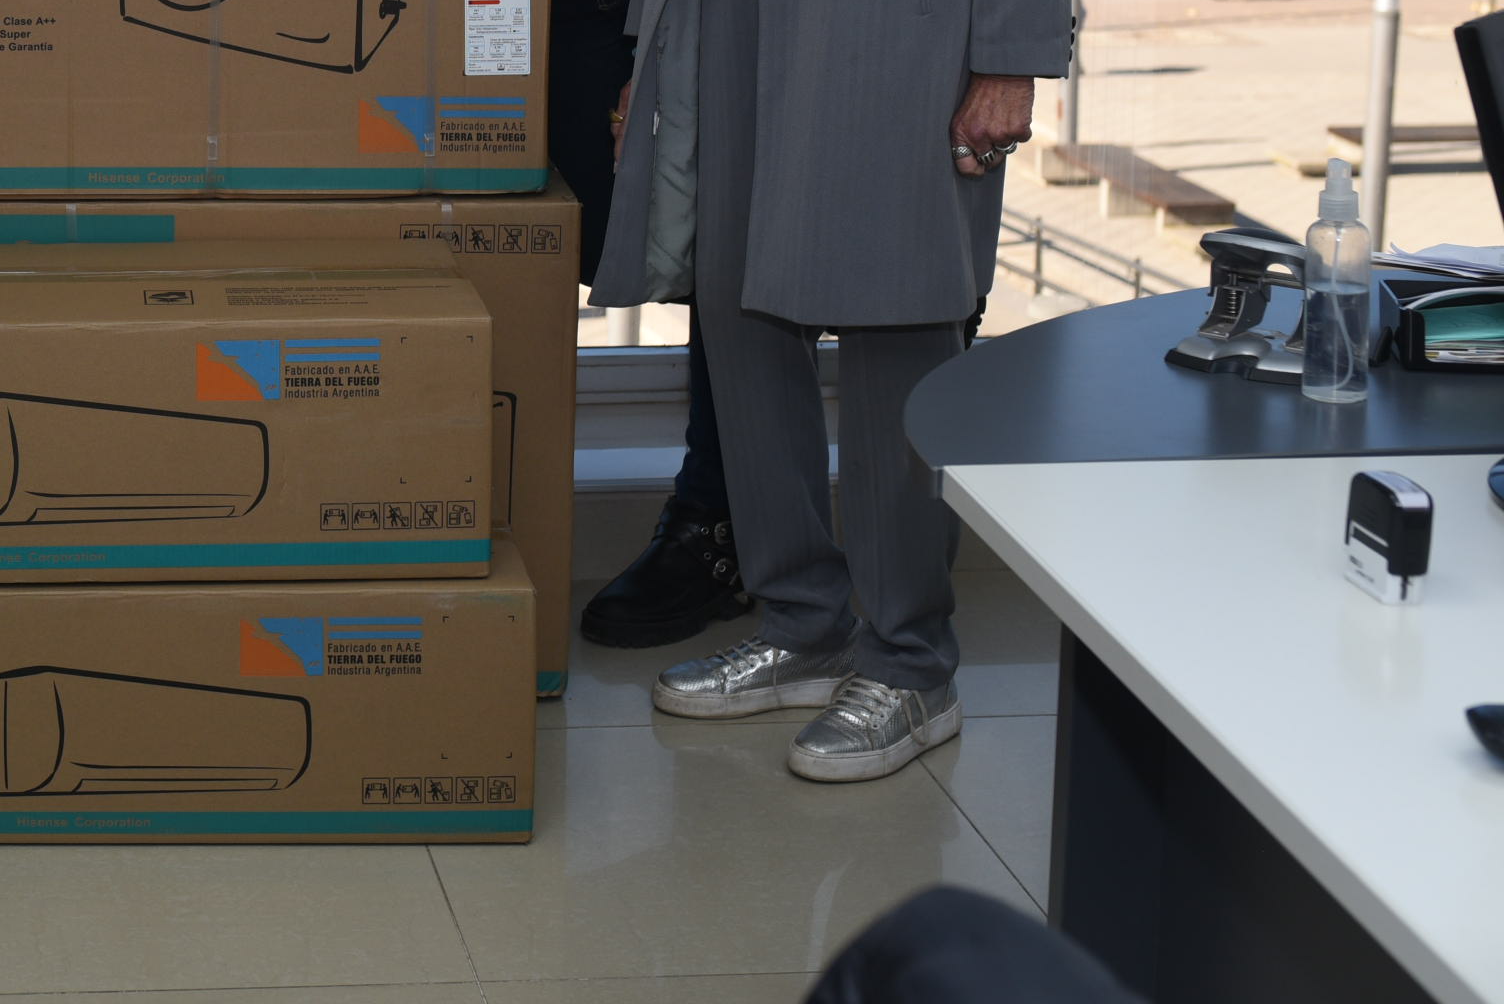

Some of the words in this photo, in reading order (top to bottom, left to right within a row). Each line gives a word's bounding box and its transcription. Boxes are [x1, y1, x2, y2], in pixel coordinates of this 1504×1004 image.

[3, 16, 32, 26] Clase
[36, 17, 56, 26] A++
[0, 30, 31, 41] Super
[8, 42, 53, 51] Garantía
[441, 122, 485, 131] Fabricado
[489, 123, 499, 131] en
[440, 133, 472, 141] TIERRA
[477, 133, 493, 141] DEL
[497, 133, 526, 141] FUEGO
[440, 143, 479, 152] Industria
[483, 143, 525, 153] Argentina
[88, 172, 140, 183] Hisense
[285, 365, 334, 375] Fabricado
[339, 366, 350, 374] en
[285, 377, 321, 387] TIERRA
[325, 377, 343, 386] DEL
[348, 376, 379, 386] FUEGO
[285, 388, 328, 398] Industria
[332, 388, 379, 399] Argentina
[328, 643, 376, 653] Fabricado
[381, 644, 392, 652] en
[328, 655, 363, 664] TIERRA
[368, 655, 386, 664] DEL
[390, 655, 421, 664] FUEGO
[328, 666, 371, 675] Industria
[374, 666, 421, 676] Argentina
[16, 817, 68, 827] Hisense
